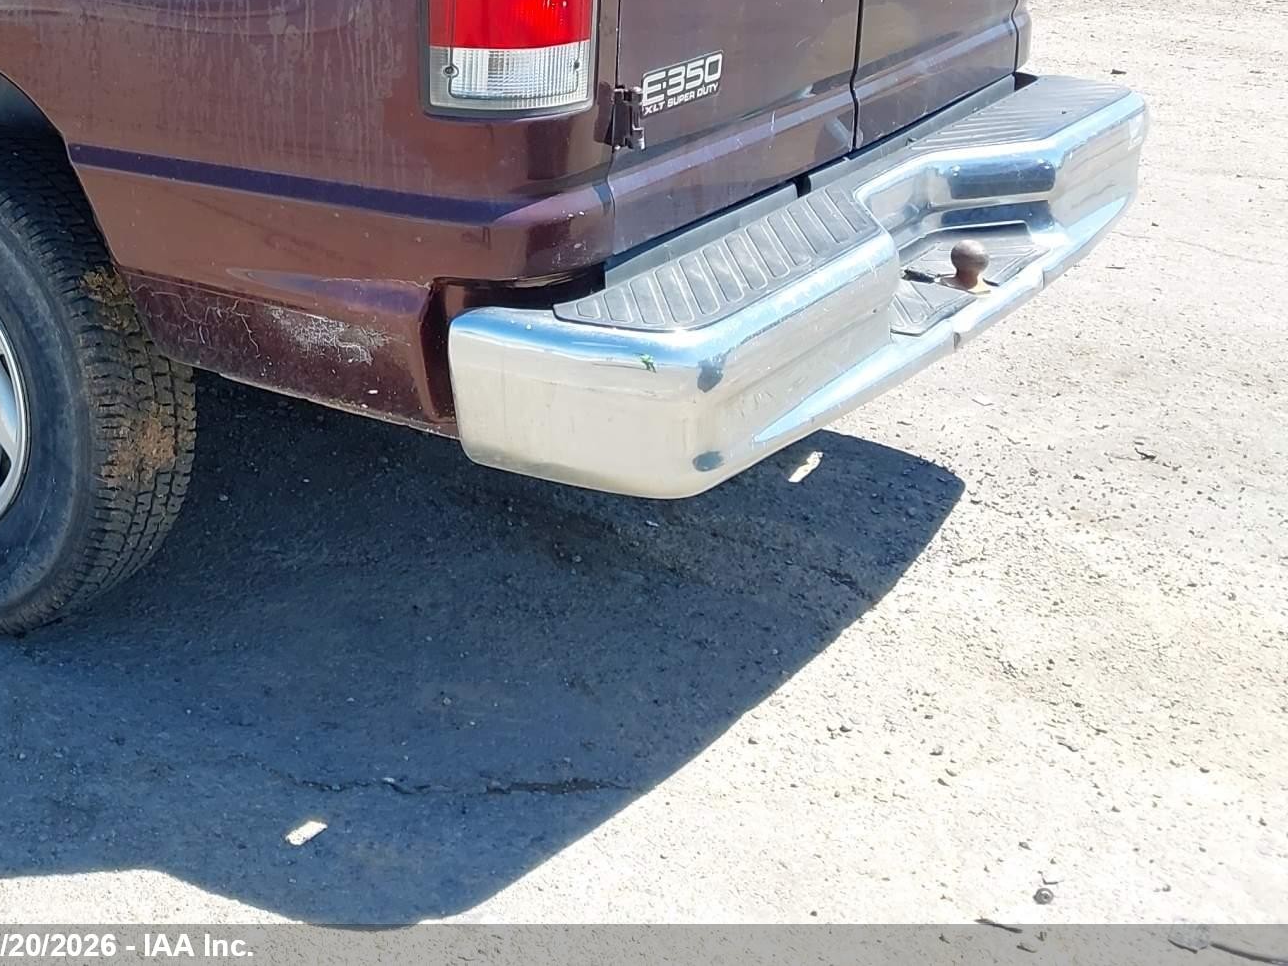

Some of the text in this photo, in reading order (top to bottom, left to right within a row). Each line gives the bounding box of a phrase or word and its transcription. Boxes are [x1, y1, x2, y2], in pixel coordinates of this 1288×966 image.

[644, 83, 719, 116] XLT SUPER DUTY
